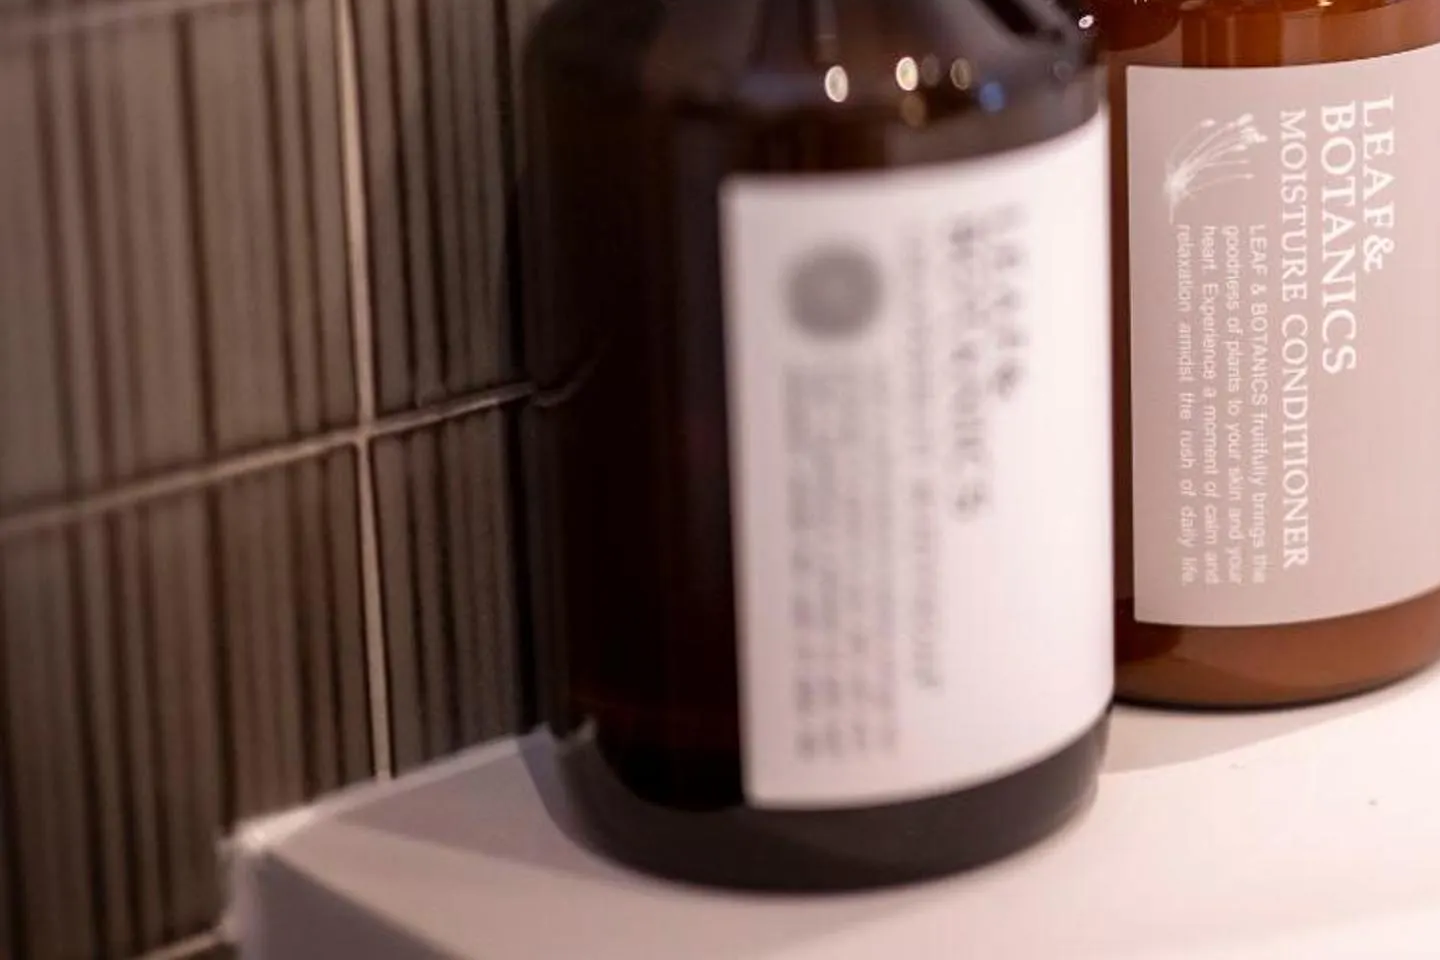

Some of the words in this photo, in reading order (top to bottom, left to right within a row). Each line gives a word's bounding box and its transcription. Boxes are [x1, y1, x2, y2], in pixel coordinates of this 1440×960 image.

[1363, 94, 1395, 273] LEAF&
[1280, 108, 1307, 303] MOISTURE
[1250, 224, 1267, 276] LEAF
[1320, 100, 1356, 376] BOTANICS
[1176, 224, 1194, 312] relaxation
[1222, 225, 1241, 310] goodness
[1251, 283, 1267, 295] &
[1199, 283, 1219, 380] Experience
[1226, 317, 1243, 335] of
[1178, 323, 1195, 382] amidst
[1223, 341, 1244, 393] plants
[1250, 302, 1268, 406] BOTANICS
[1179, 393, 1195, 420] the
[1203, 387, 1217, 398] a
[1228, 399, 1244, 417] to
[1180, 430, 1196, 468] rush
[1203, 405, 1219, 475] moment
[1224, 422, 1241, 459] your
[1248, 413, 1268, 486] fruitfully
[1281, 314, 1310, 570] CONDITIONER
[1180, 479, 1197, 496] of
[1203, 481, 1220, 498] of
[1228, 466, 1244, 501] skin
[1177, 505, 1197, 548] daily
[1203, 503, 1220, 544] calm
[1228, 508, 1244, 540] and
[1248, 493, 1267, 548] brings
[1204, 551, 1220, 584] and
[1224, 546, 1242, 584] your
